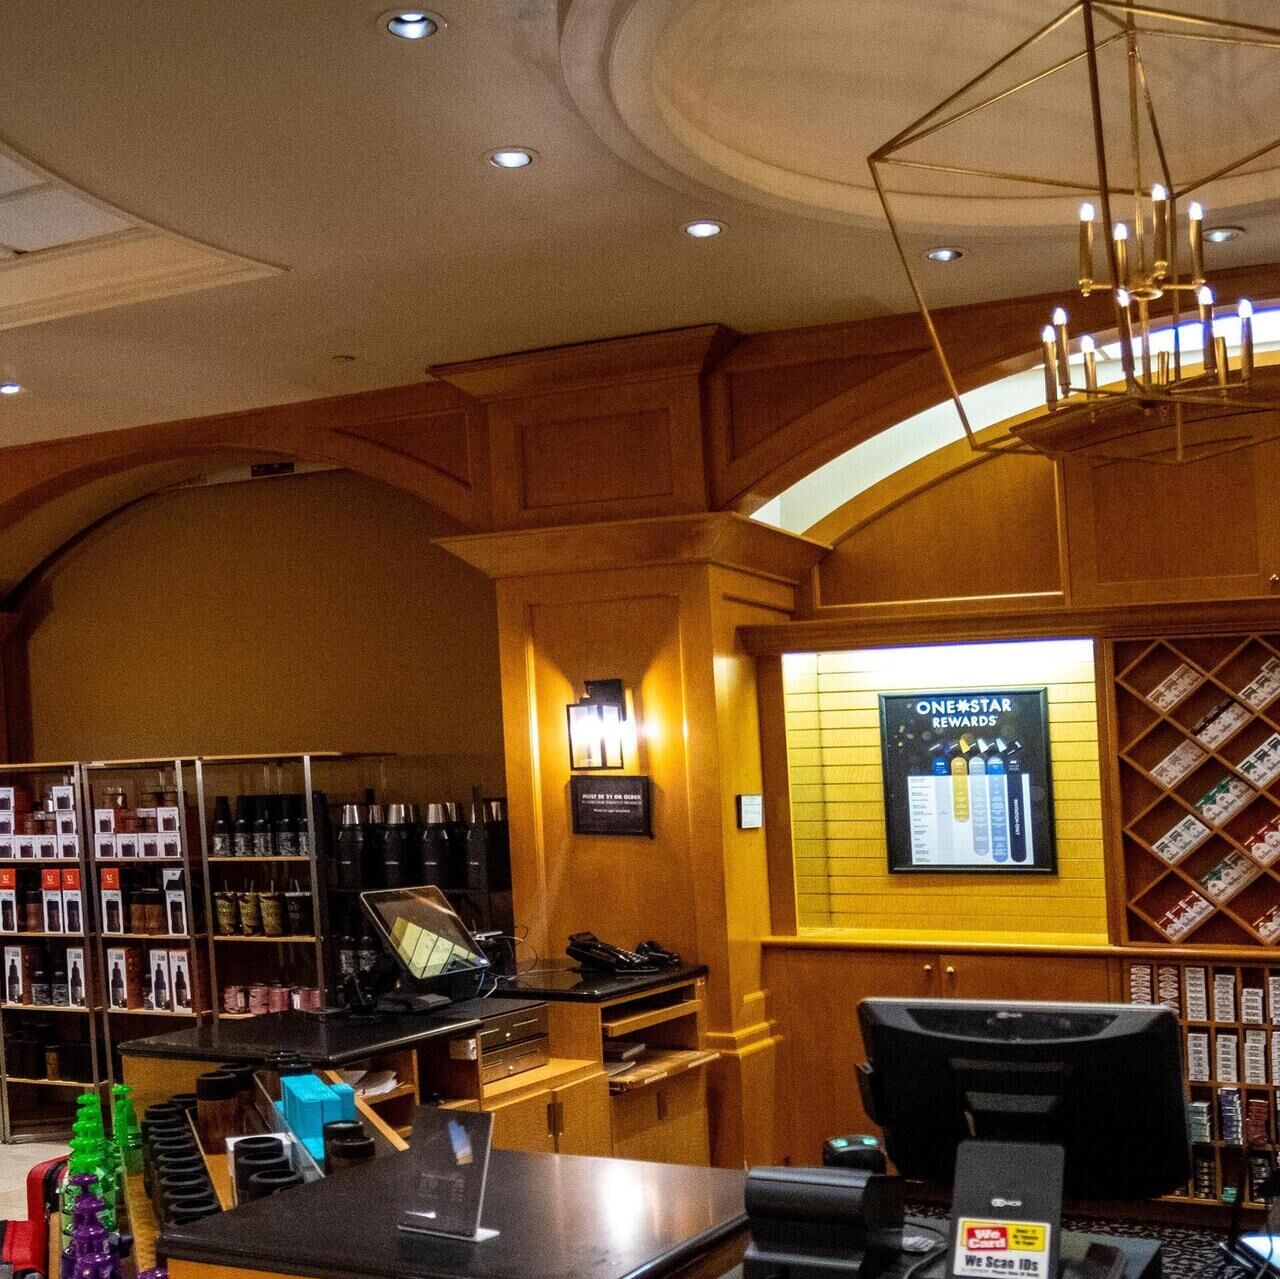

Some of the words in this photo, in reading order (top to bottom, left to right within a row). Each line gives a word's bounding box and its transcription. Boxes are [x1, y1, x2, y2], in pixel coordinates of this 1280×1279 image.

[932, 715, 998, 729] REWARDS
[974, 1229, 1001, 1240] We
[968, 1238, 1006, 1249] Card
[965, 1254, 982, 1268] We
[985, 1256, 1015, 1270] Scan
[1019, 1258, 1039, 1272] IDs
